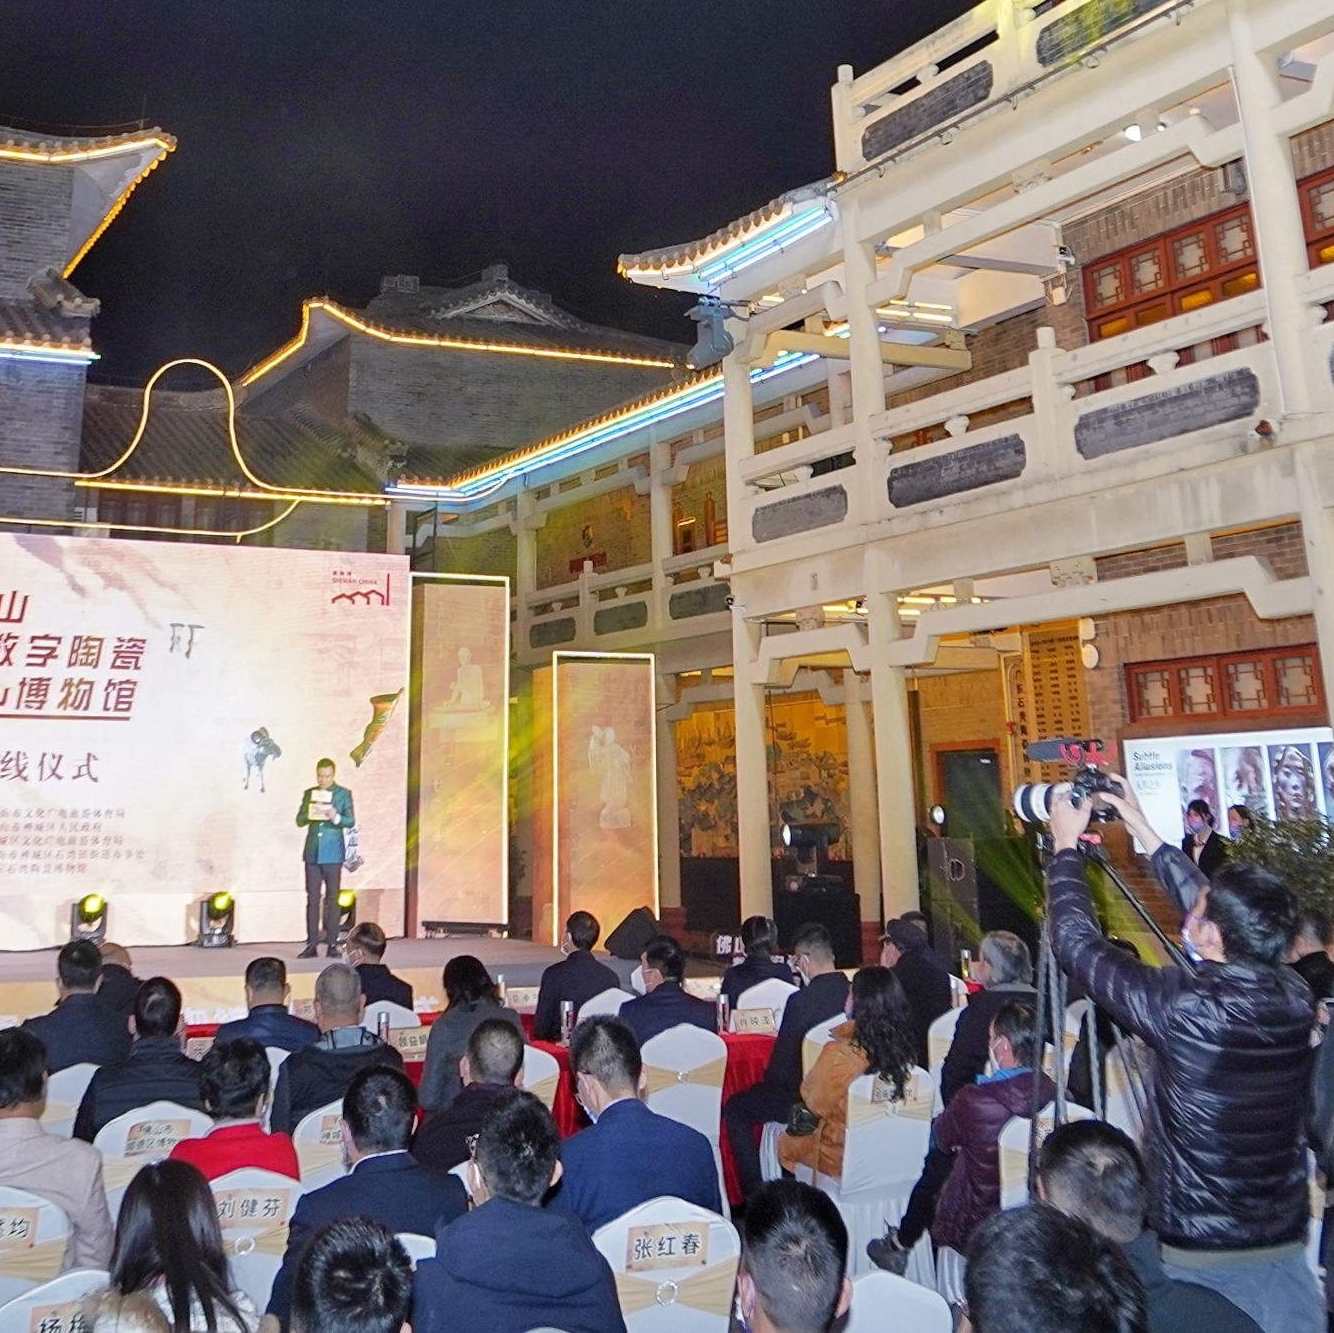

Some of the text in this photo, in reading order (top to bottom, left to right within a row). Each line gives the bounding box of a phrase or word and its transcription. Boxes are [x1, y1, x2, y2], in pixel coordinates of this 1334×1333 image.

[1133, 751, 1161, 762] Subtle
[1134, 761, 1174, 772] Allusions
[218, 1197, 281, 1219] 刘健芬
[634, 1233, 701, 1260] 张红春
